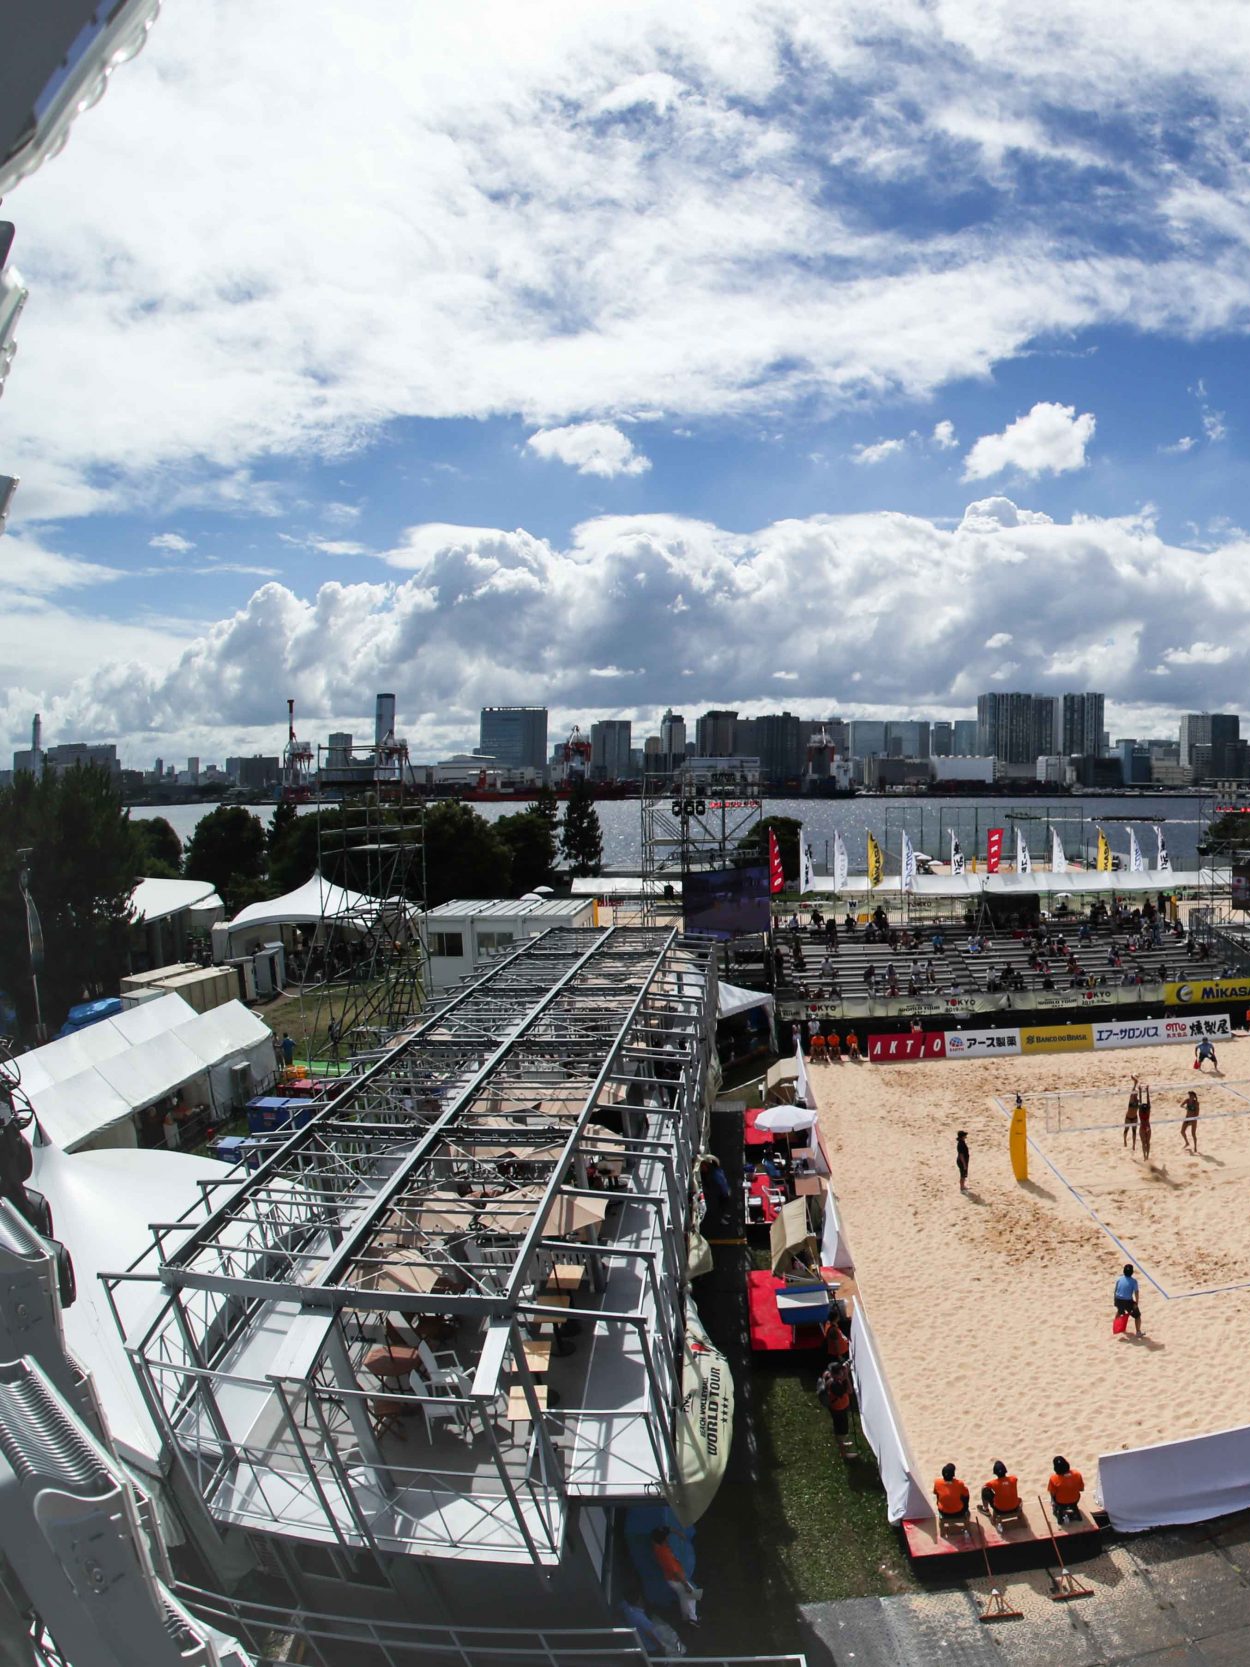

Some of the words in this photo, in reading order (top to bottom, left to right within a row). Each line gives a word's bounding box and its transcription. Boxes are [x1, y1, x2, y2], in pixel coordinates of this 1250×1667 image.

[1081, 991, 1111, 1000] TOKYO
[967, 1031, 1017, 1048] アース製薬
[1036, 1036, 1058, 1044] BANCO
[1058, 1035, 1066, 1043] DO
[1066, 1033, 1088, 1042] BRASIL
[873, 1038, 941, 1058] AKTIO
[709, 1366, 721, 1398] TOUR
[706, 1401, 720, 1456] WORLD
